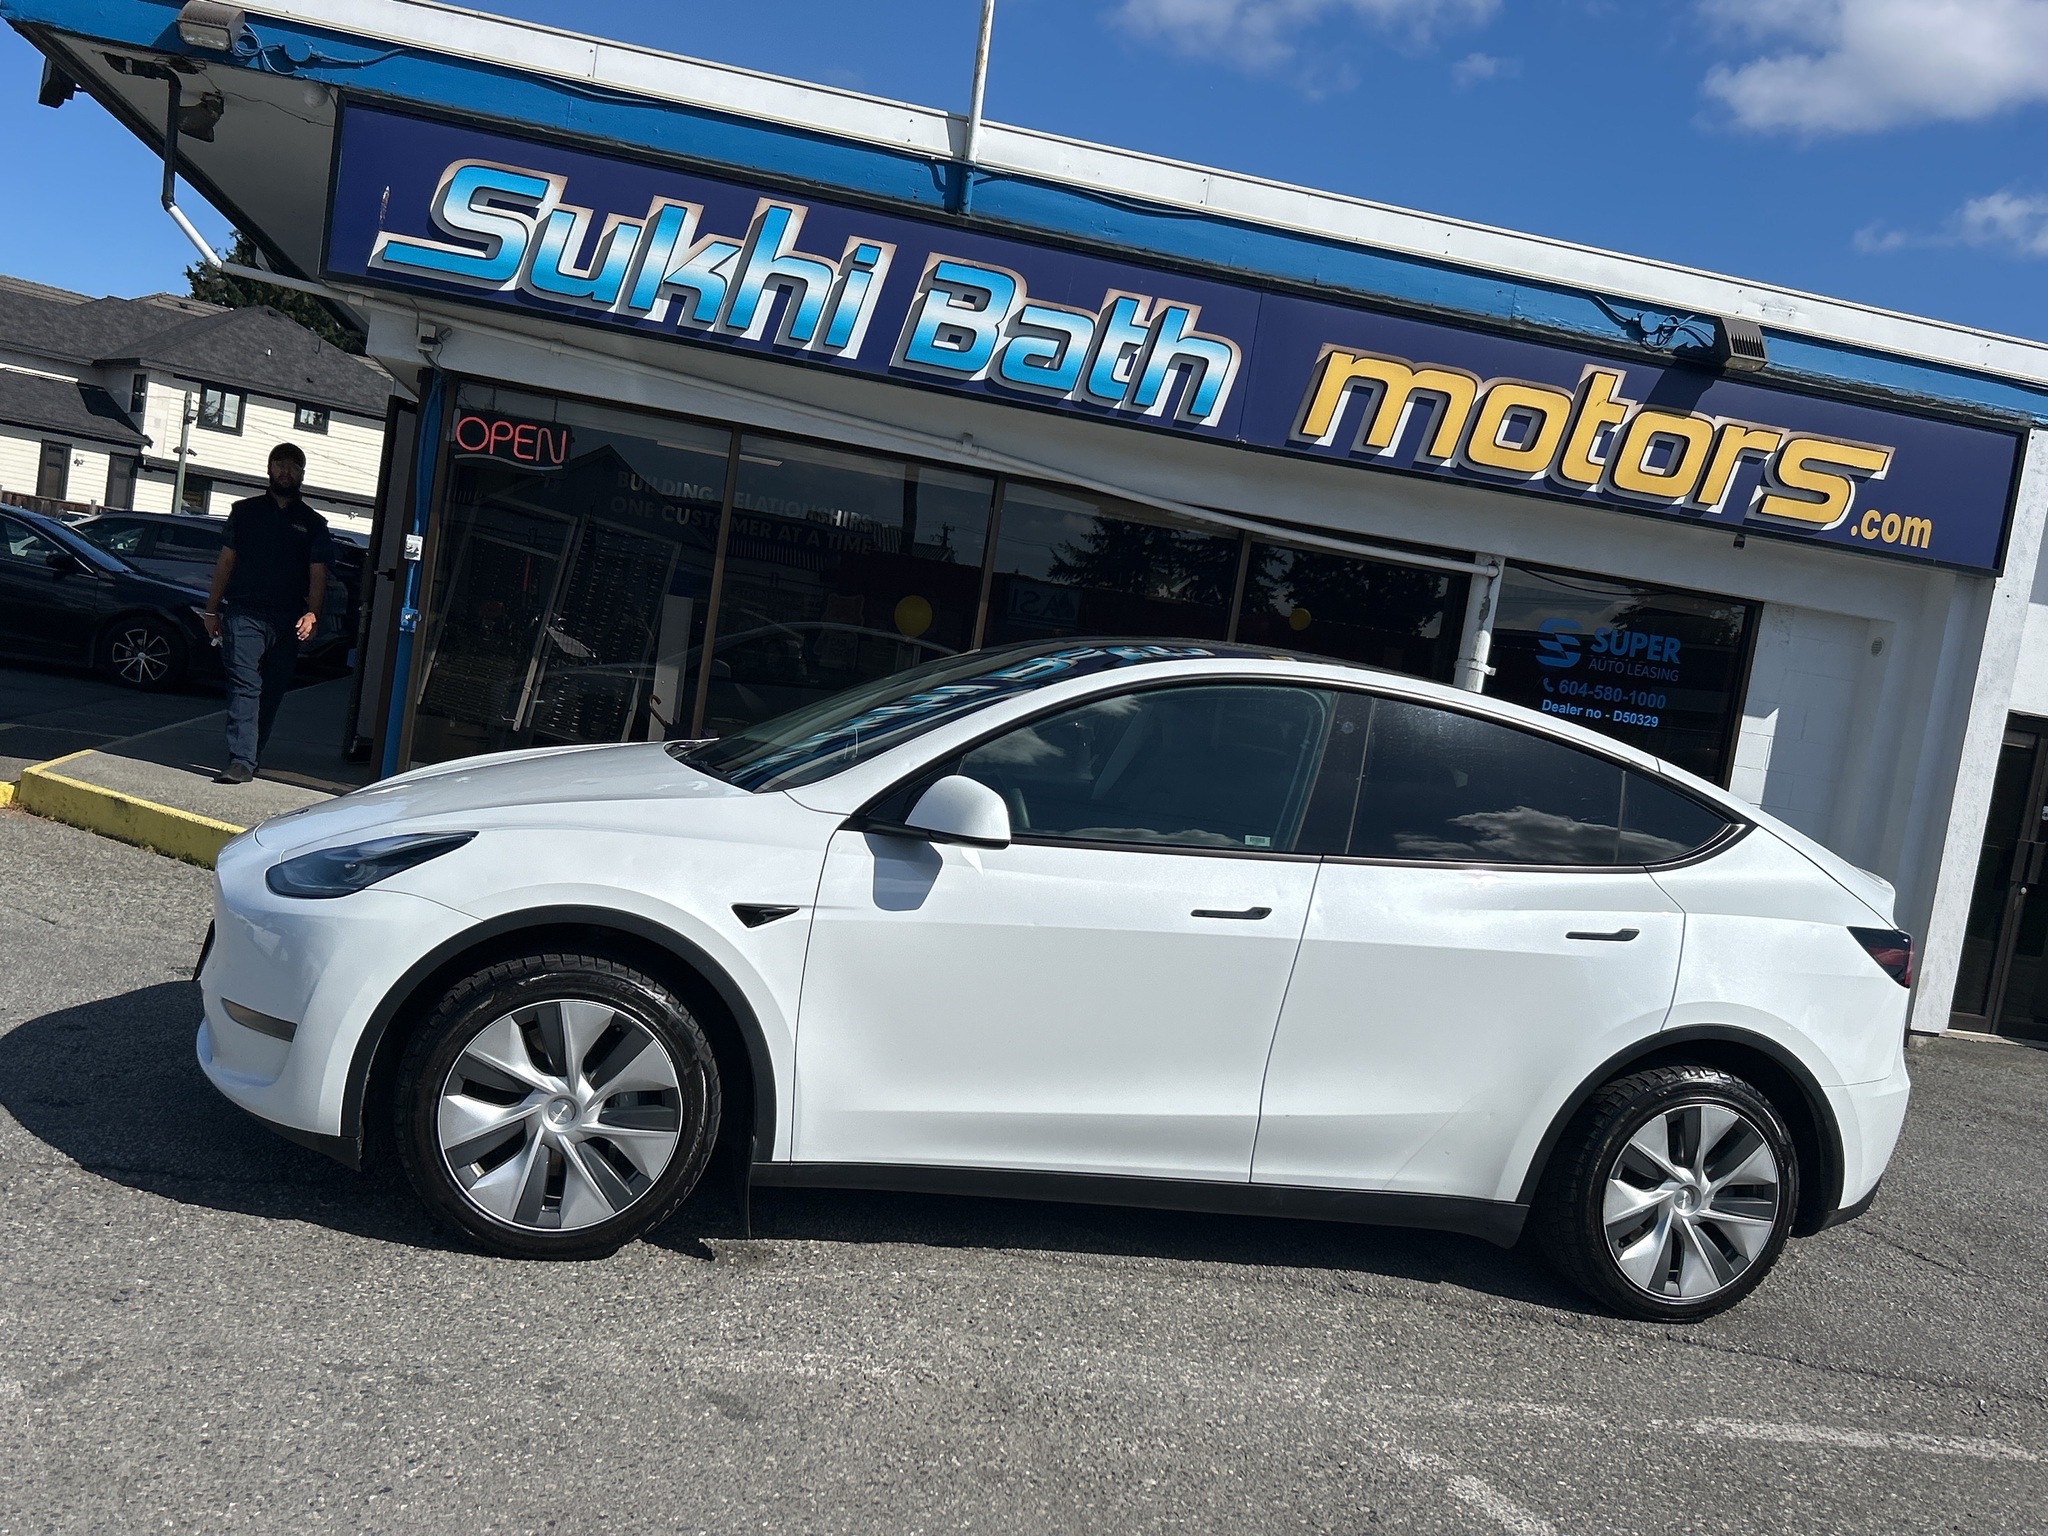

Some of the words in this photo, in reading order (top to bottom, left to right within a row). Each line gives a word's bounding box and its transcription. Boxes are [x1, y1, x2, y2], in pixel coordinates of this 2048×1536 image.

[368, 158, 896, 360] Sukhi
[890, 252, 1242, 427] Bath
[1286, 344, 1894, 531] motors
[1850, 507, 1933, 549] .com
[455, 416, 567, 464] OPEN
[611, 496, 655, 518] ONE
[661, 505, 772, 539] CUSTOMER
[777, 525, 803, 543] AT
[806, 530, 821, 547] A
[827, 532, 874, 555] TIME
[720, 491, 875, 533] ELATIONSHIPS
[1590, 627, 1681, 664] SUPER
[1588, 657, 1625, 674] AUTO
[1626, 663, 1680, 682] LEASING
[1541, 699, 1582, 717] Dealer
[1585, 708, 1602, 719] no
[1612, 710, 1659, 728] D50329
[1558, 679, 1667, 710] 604-580-1000
